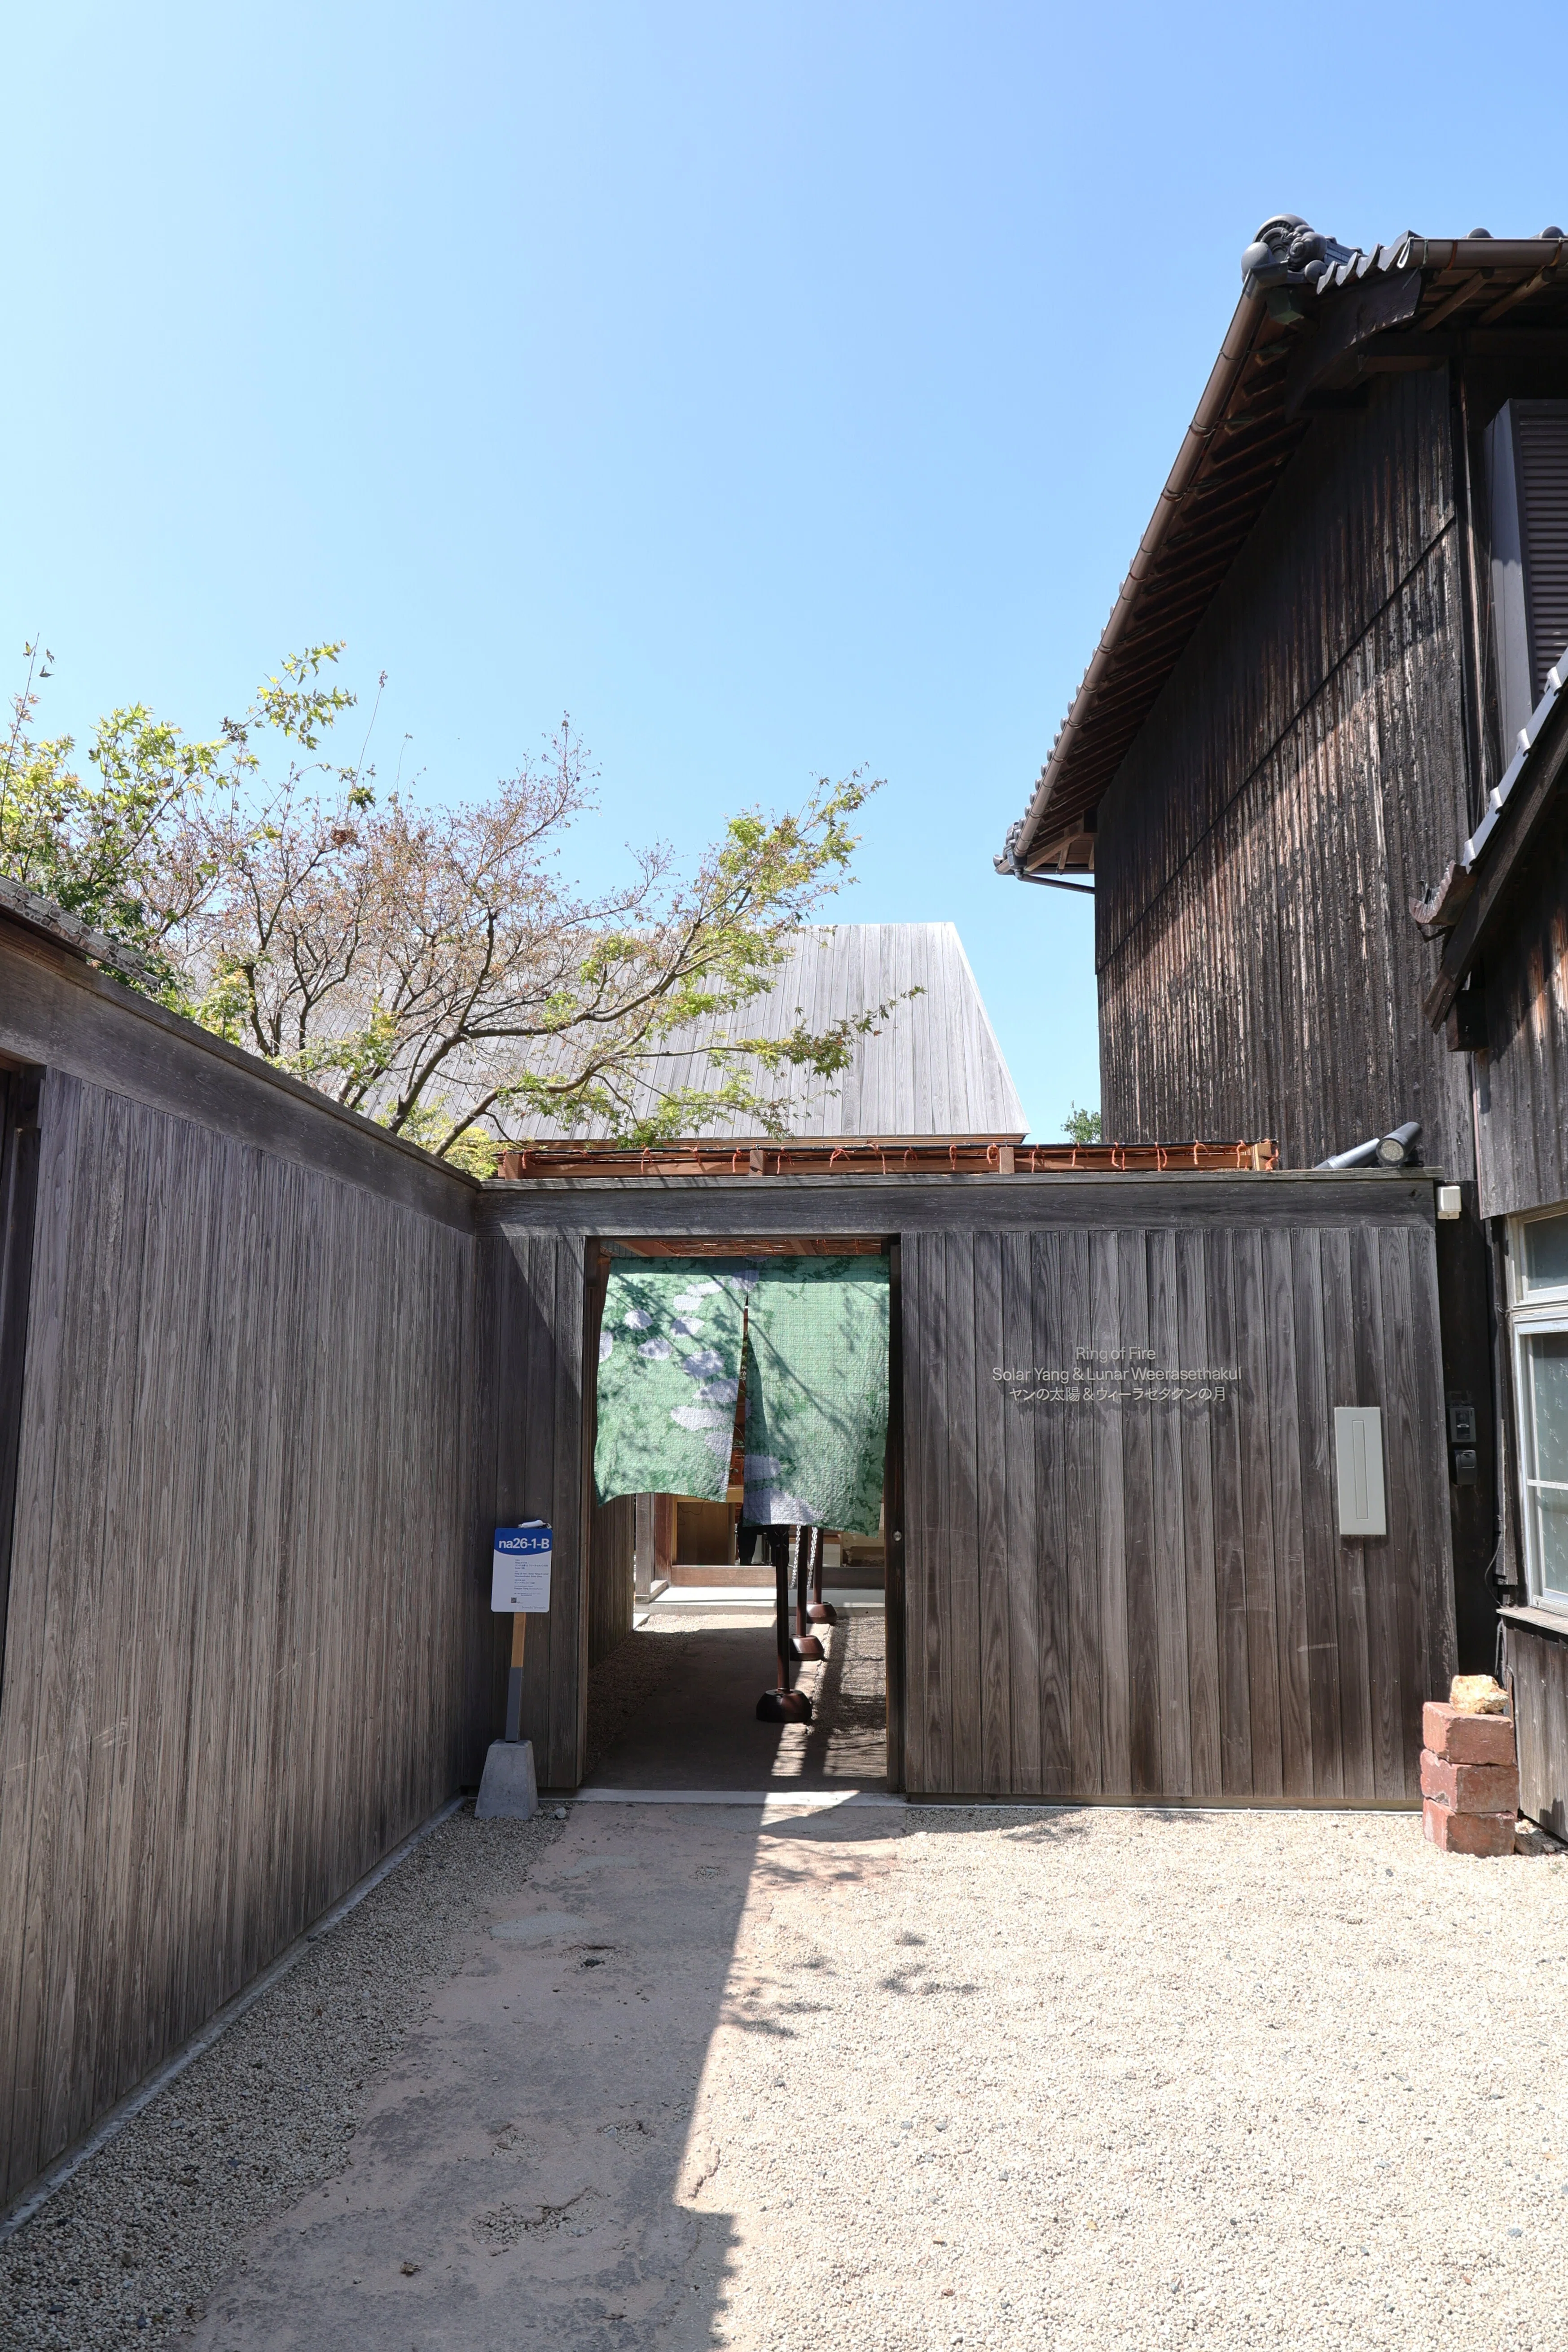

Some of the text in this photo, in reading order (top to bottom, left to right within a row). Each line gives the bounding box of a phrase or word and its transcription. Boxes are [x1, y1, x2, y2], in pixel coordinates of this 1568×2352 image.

[1076, 1347, 1156, 1363] Ring of Fire
[993, 1367, 1242, 1384] Solar Yang & Lunar Weerasethakul
[499, 1538, 549, 1549] na26-1-B
